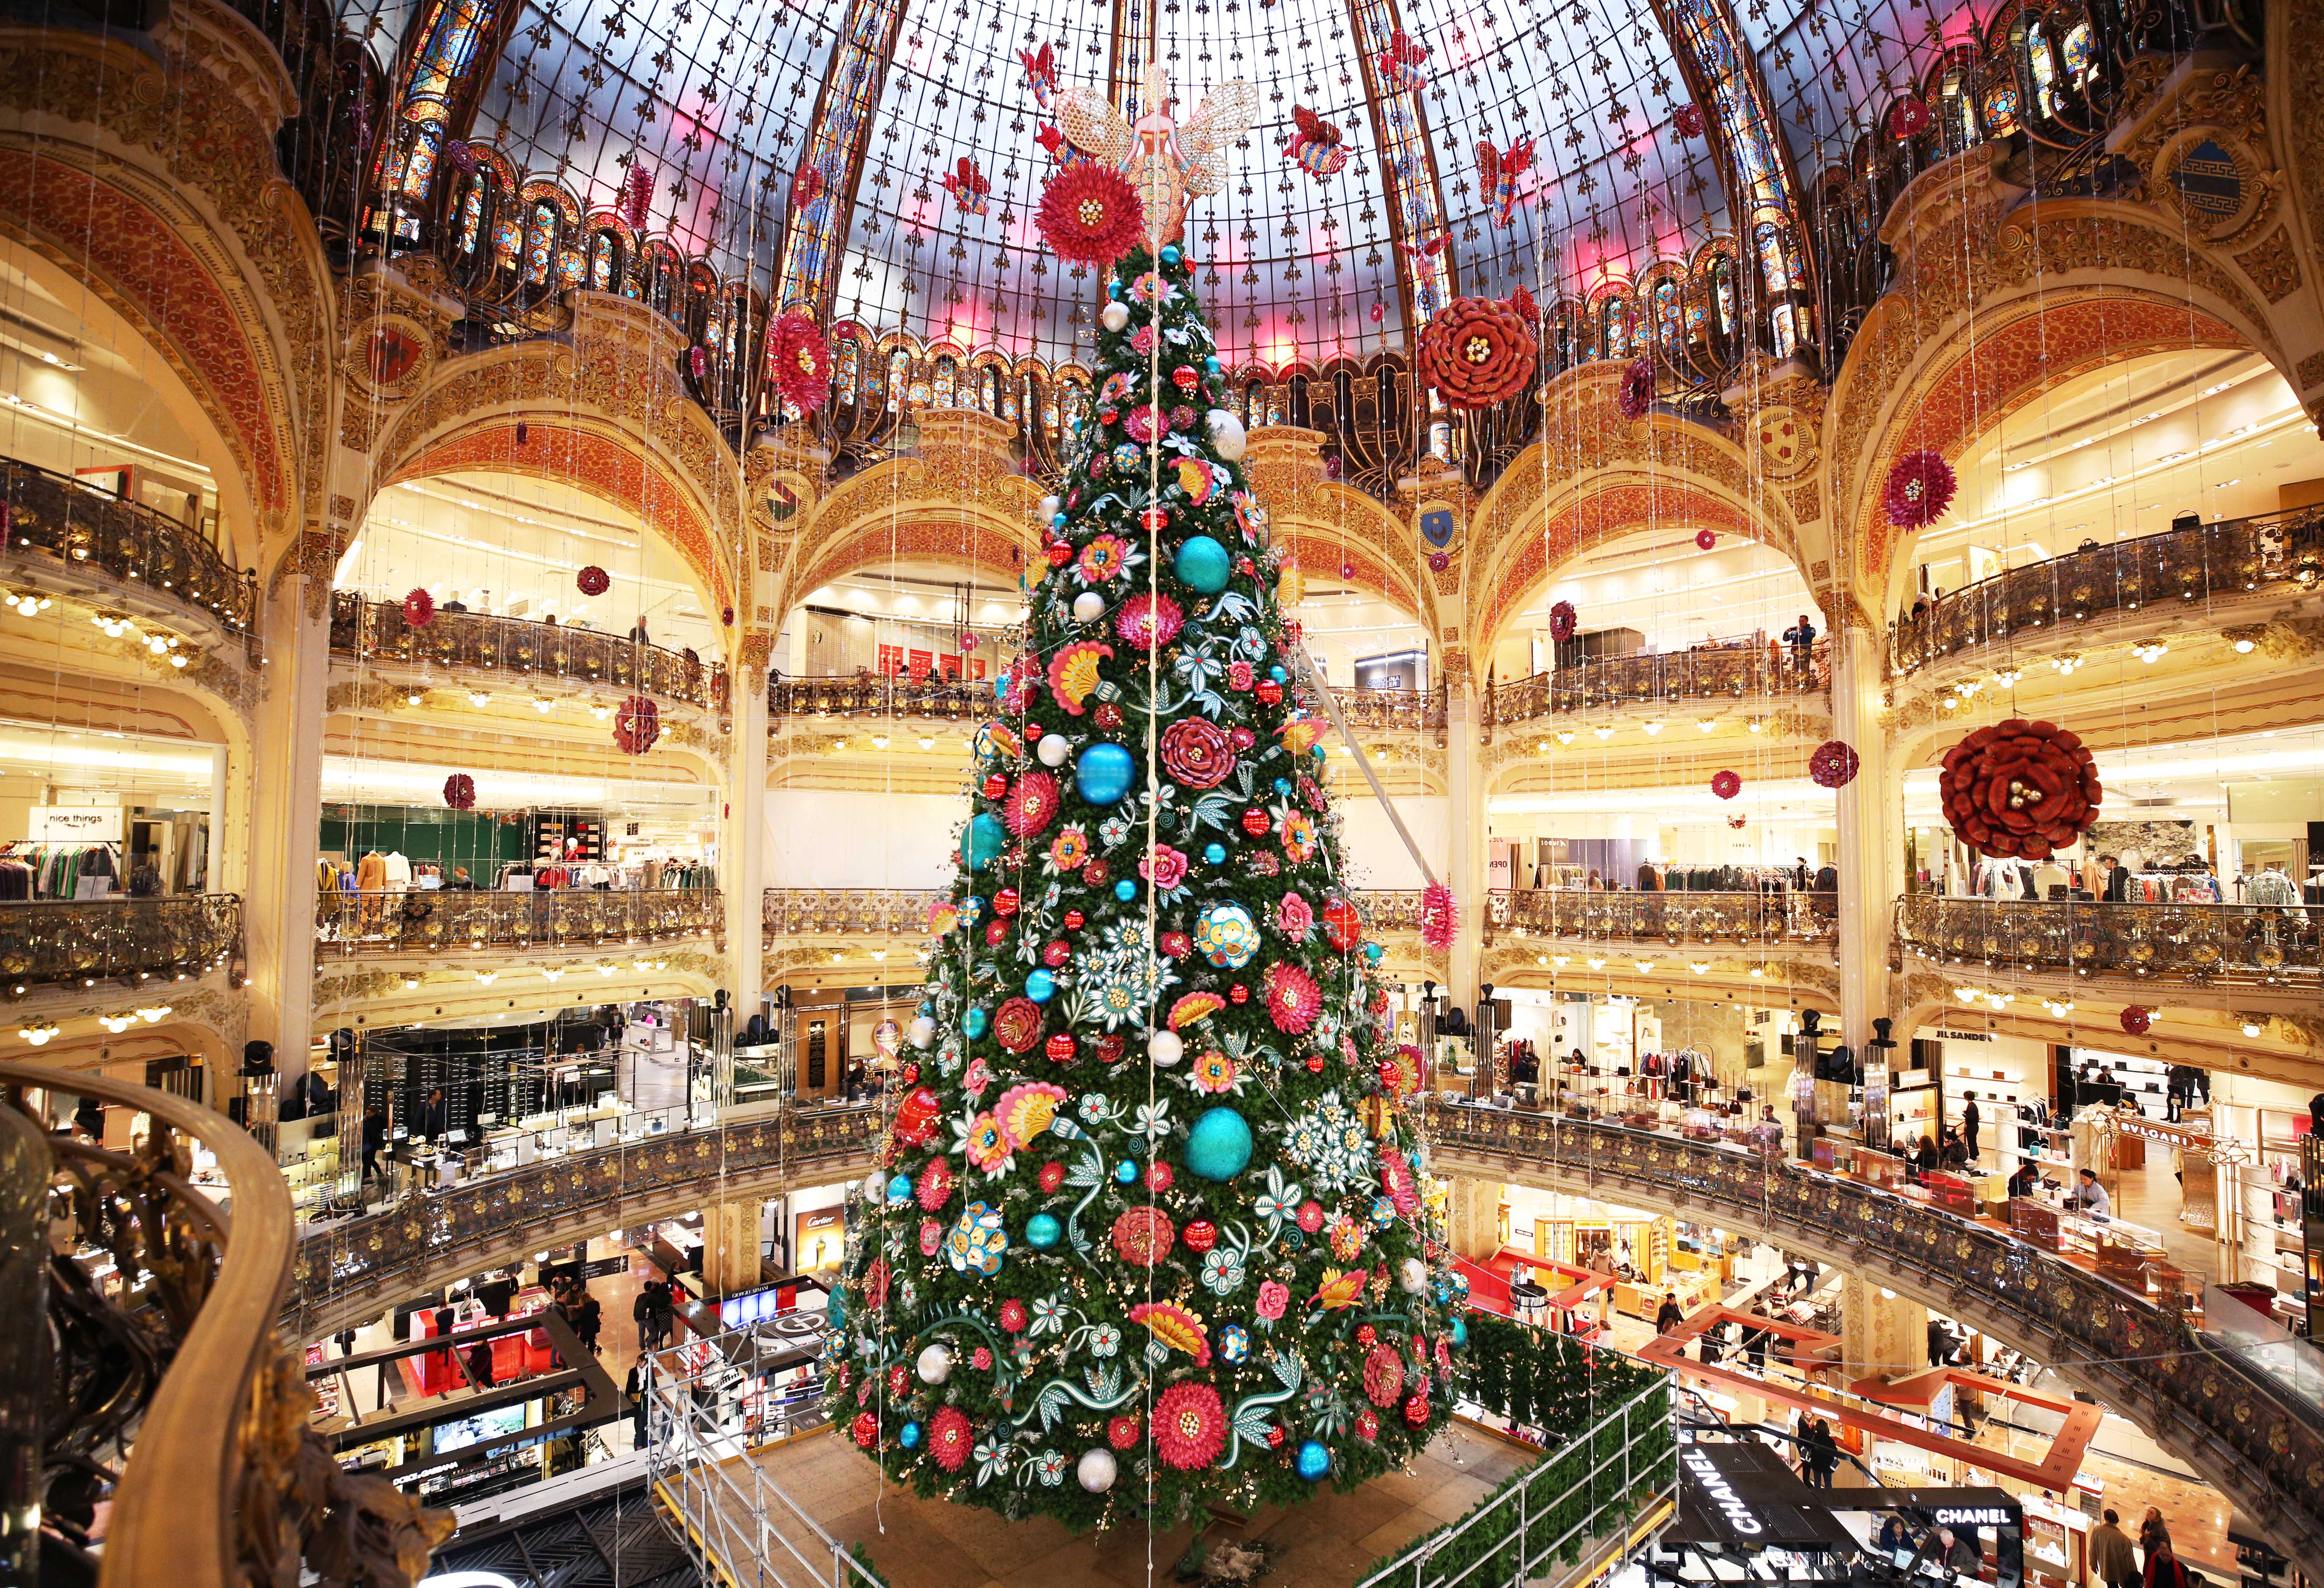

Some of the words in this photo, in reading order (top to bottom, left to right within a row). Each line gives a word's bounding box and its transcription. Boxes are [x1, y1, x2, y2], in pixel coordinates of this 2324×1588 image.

[1368, 676, 1400, 685] CAROLINA
[73, 814, 102, 824] things
[1950, 1032, 1993, 1042] SANDER
[2121, 1122, 2188, 1146] BVLGARI
[807, 1216, 835, 1227] Cartier
[732, 1290, 751, 1298] GIORGIO
[752, 1285, 769, 1293] ARMANI
[1682, 1448, 1762, 1534] CHANEL
[1935, 1509, 2011, 1524] CHANEL
